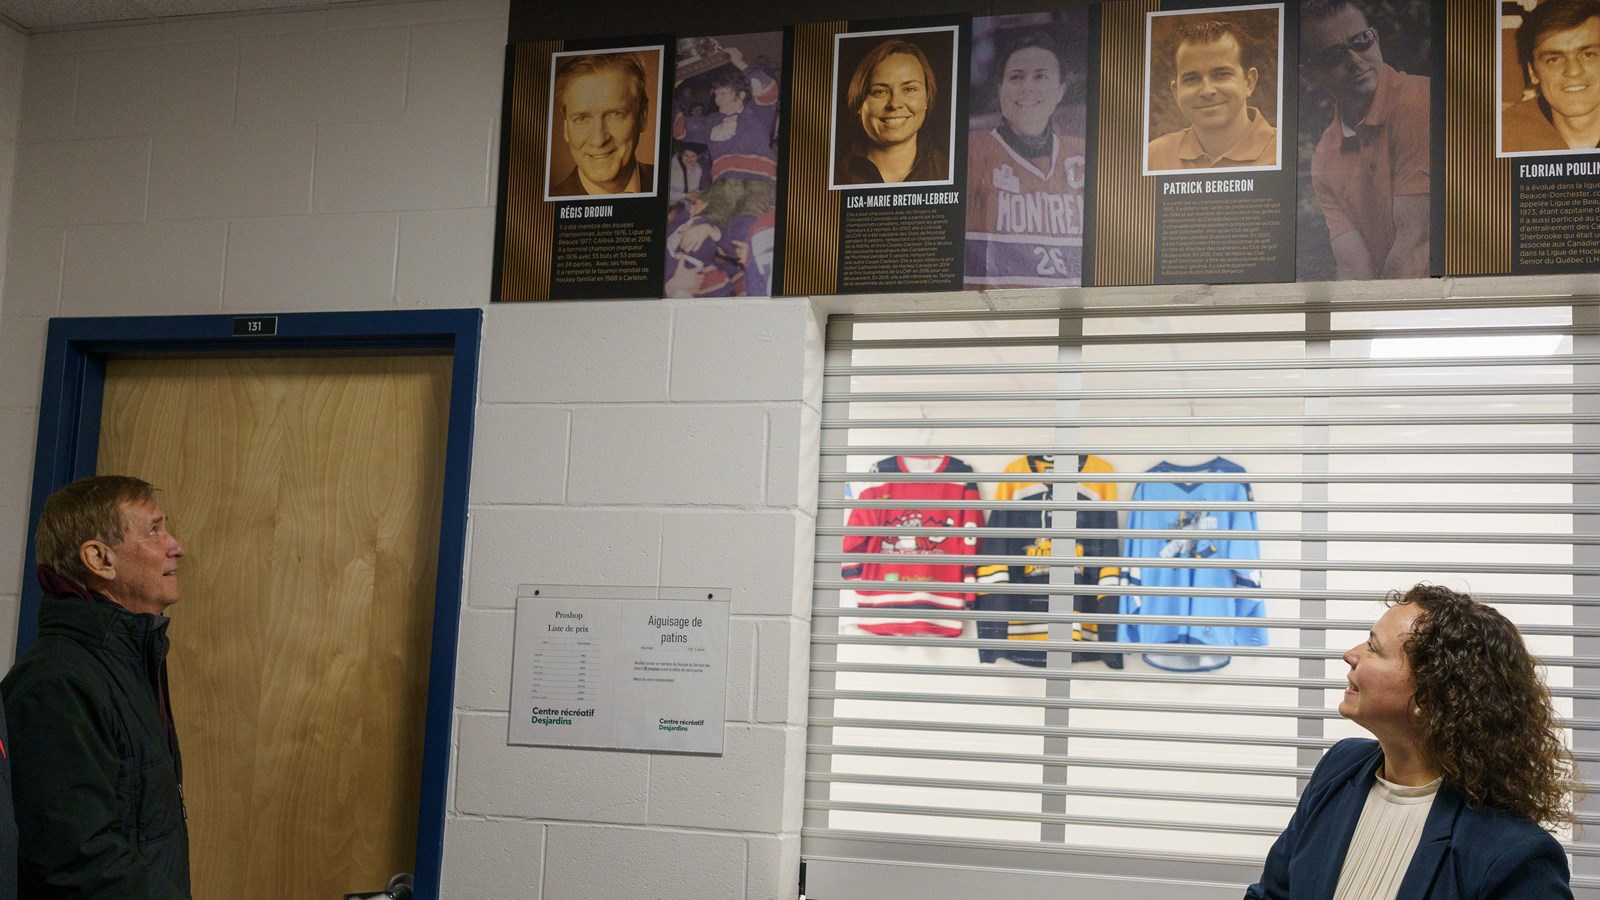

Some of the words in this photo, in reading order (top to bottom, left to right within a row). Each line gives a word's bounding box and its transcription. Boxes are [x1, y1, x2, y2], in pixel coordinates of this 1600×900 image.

[1520, 163, 1563, 178] FLORIAN
[1164, 182, 1202, 194] PATRICK
[1206, 179, 1254, 193] BERGERON
[847, 196, 890, 208] LISA-MARIE
[893, 192, 959, 207] BRETON-LEBREUX
[560, 205, 582, 219] RÉGIS
[584, 206, 613, 218] DROUIN
[1035, 246, 1067, 274] 26
[248, 322, 262, 332] 131
[555, 611, 583, 620] Proshop
[648, 615, 689, 629] Aiguisage
[692, 617, 702, 627] de
[661, 633, 687, 645] patins
[532, 707, 559, 715] Centre
[560, 707, 594, 717] récréatif
[531, 716, 572, 727] Desjardins
